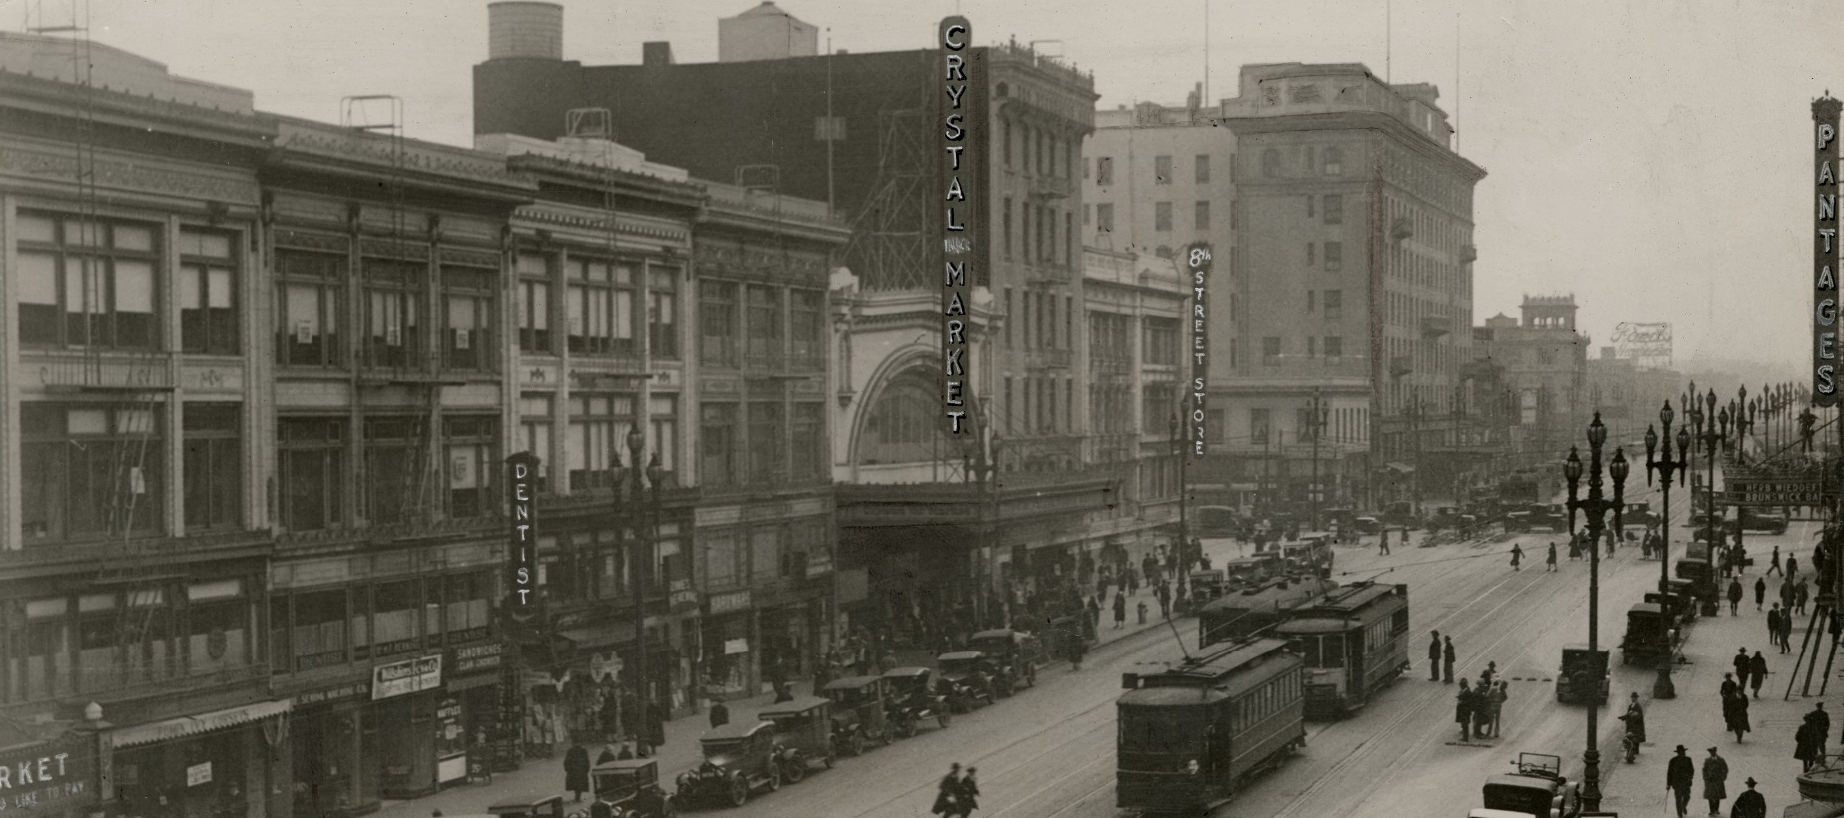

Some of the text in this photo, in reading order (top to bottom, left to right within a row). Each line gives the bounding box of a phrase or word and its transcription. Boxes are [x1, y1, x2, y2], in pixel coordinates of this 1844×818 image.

[945, 25, 966, 231] CRYSTAL
[1816, 123, 1836, 394] PANTAGES
[945, 261, 966, 434] MARKET
[1189, 248, 1211, 455] 8th STREET STORE
[515, 463, 530, 605] DENTIST
[1745, 493, 1818, 502] BRUNSWICK BA
[1746, 483, 1770, 492] HERB
[15, 790, 39, 809] LIKE
[65, 781, 84, 796] PAY
